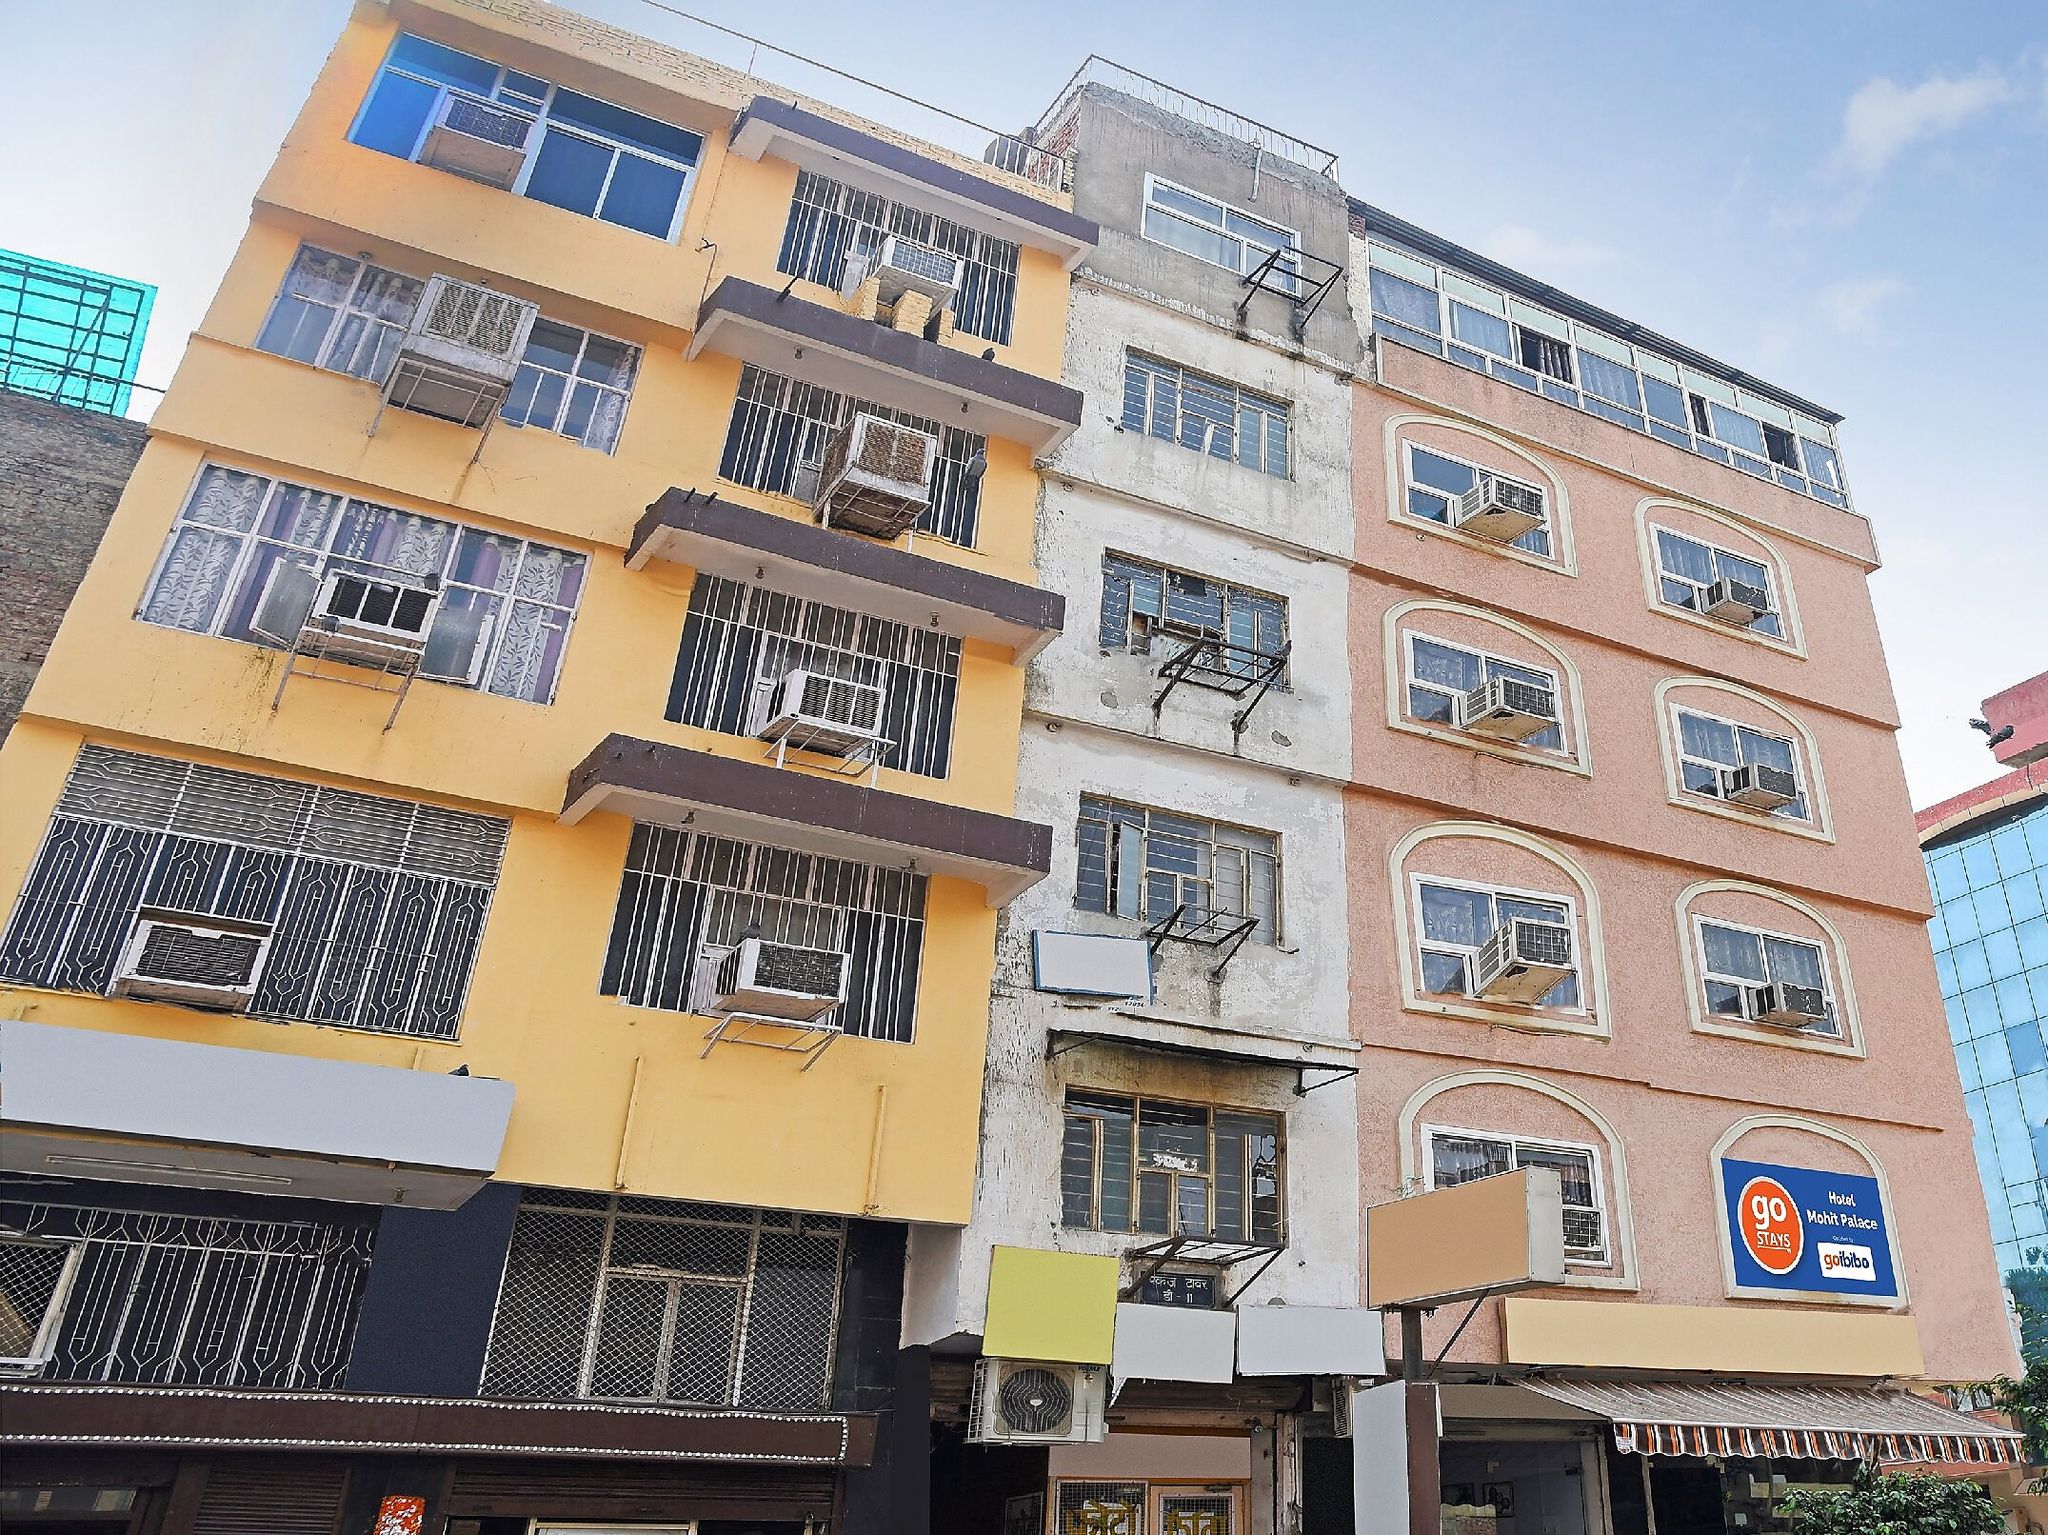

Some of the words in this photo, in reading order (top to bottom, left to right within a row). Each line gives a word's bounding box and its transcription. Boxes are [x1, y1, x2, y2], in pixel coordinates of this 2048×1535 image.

[1828, 1190, 1857, 1207] Hotel
[1751, 1195, 1787, 1230] go
[1806, 1209, 1840, 1226] Mohit
[1840, 1213, 1879, 1230] Palace
[1756, 1230, 1791, 1248] STAYS
[1823, 1250, 1870, 1270] goibibo
[1184, 1278, 1209, 1290] टावर
